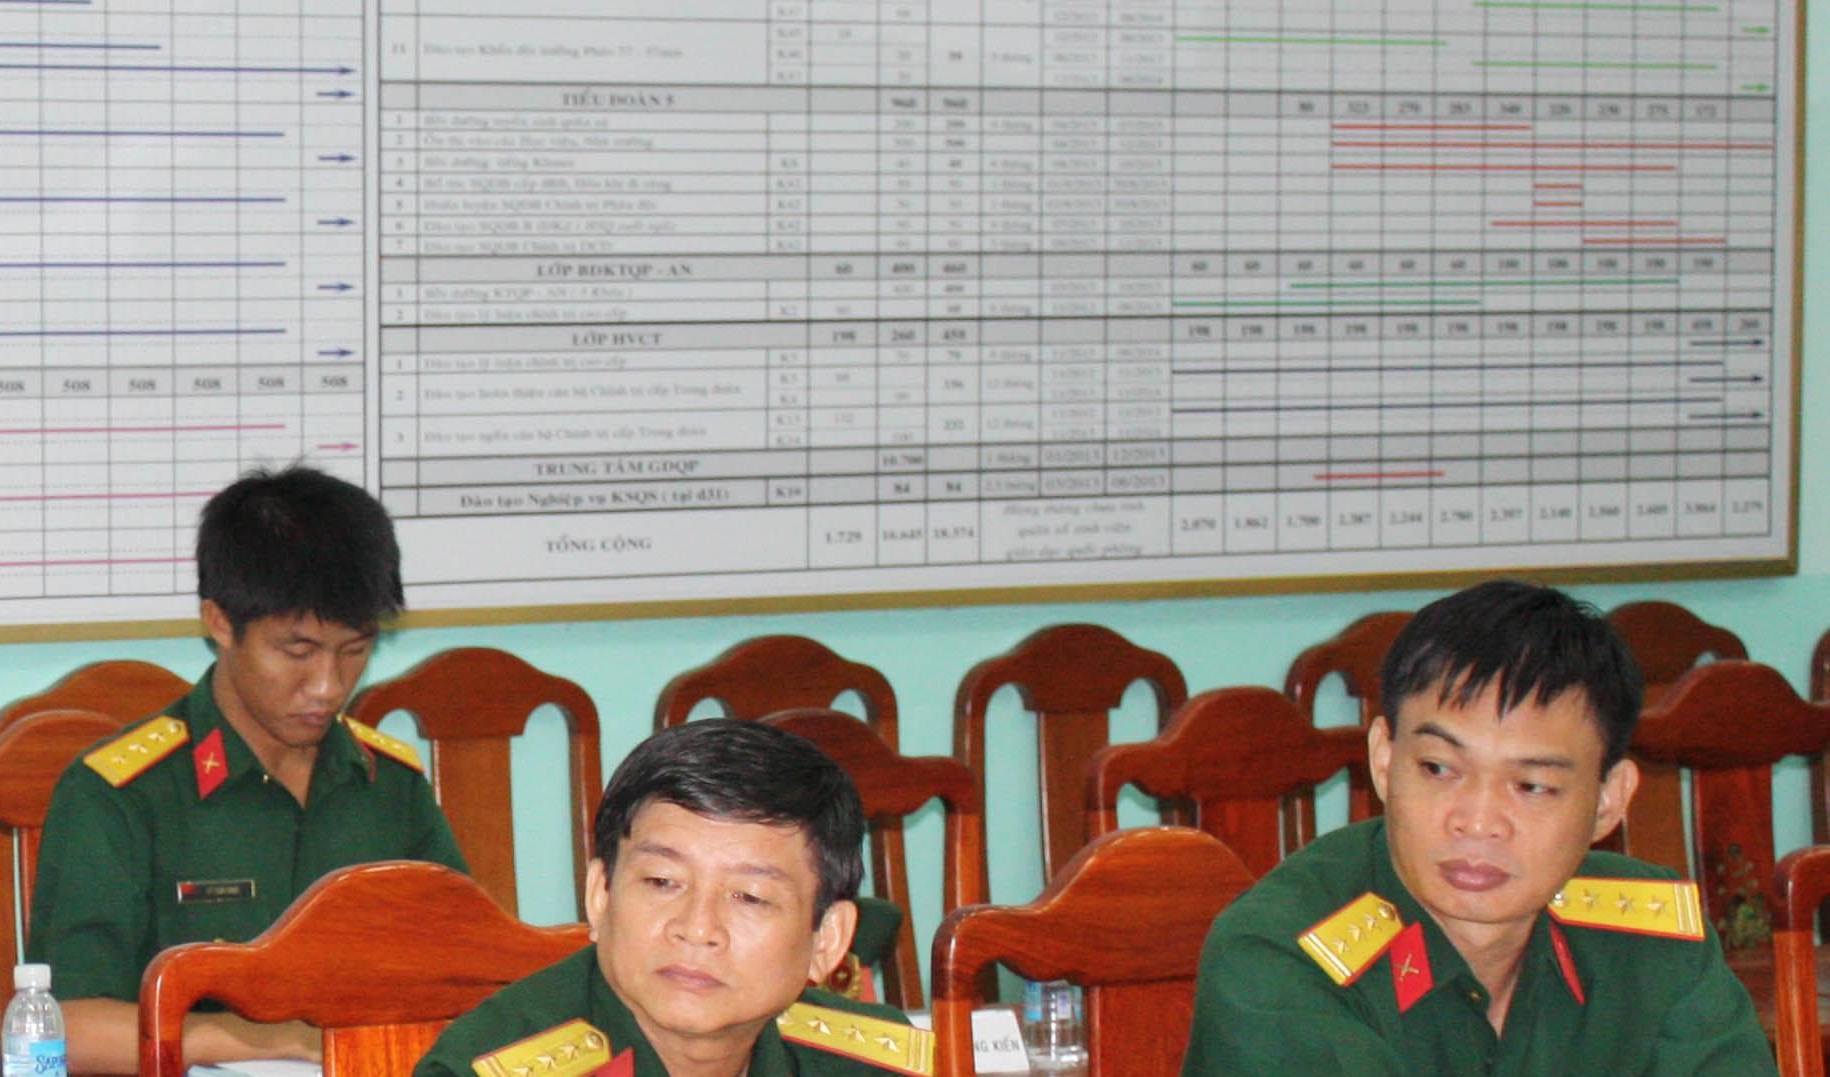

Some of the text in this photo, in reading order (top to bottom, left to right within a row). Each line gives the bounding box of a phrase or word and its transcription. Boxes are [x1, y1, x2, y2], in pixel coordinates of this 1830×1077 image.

[63, 380, 90, 392] 508
[129, 380, 156, 390] 508
[194, 379, 221, 389] 508
[258, 377, 285, 391] 508
[322, 376, 348, 387] 508
